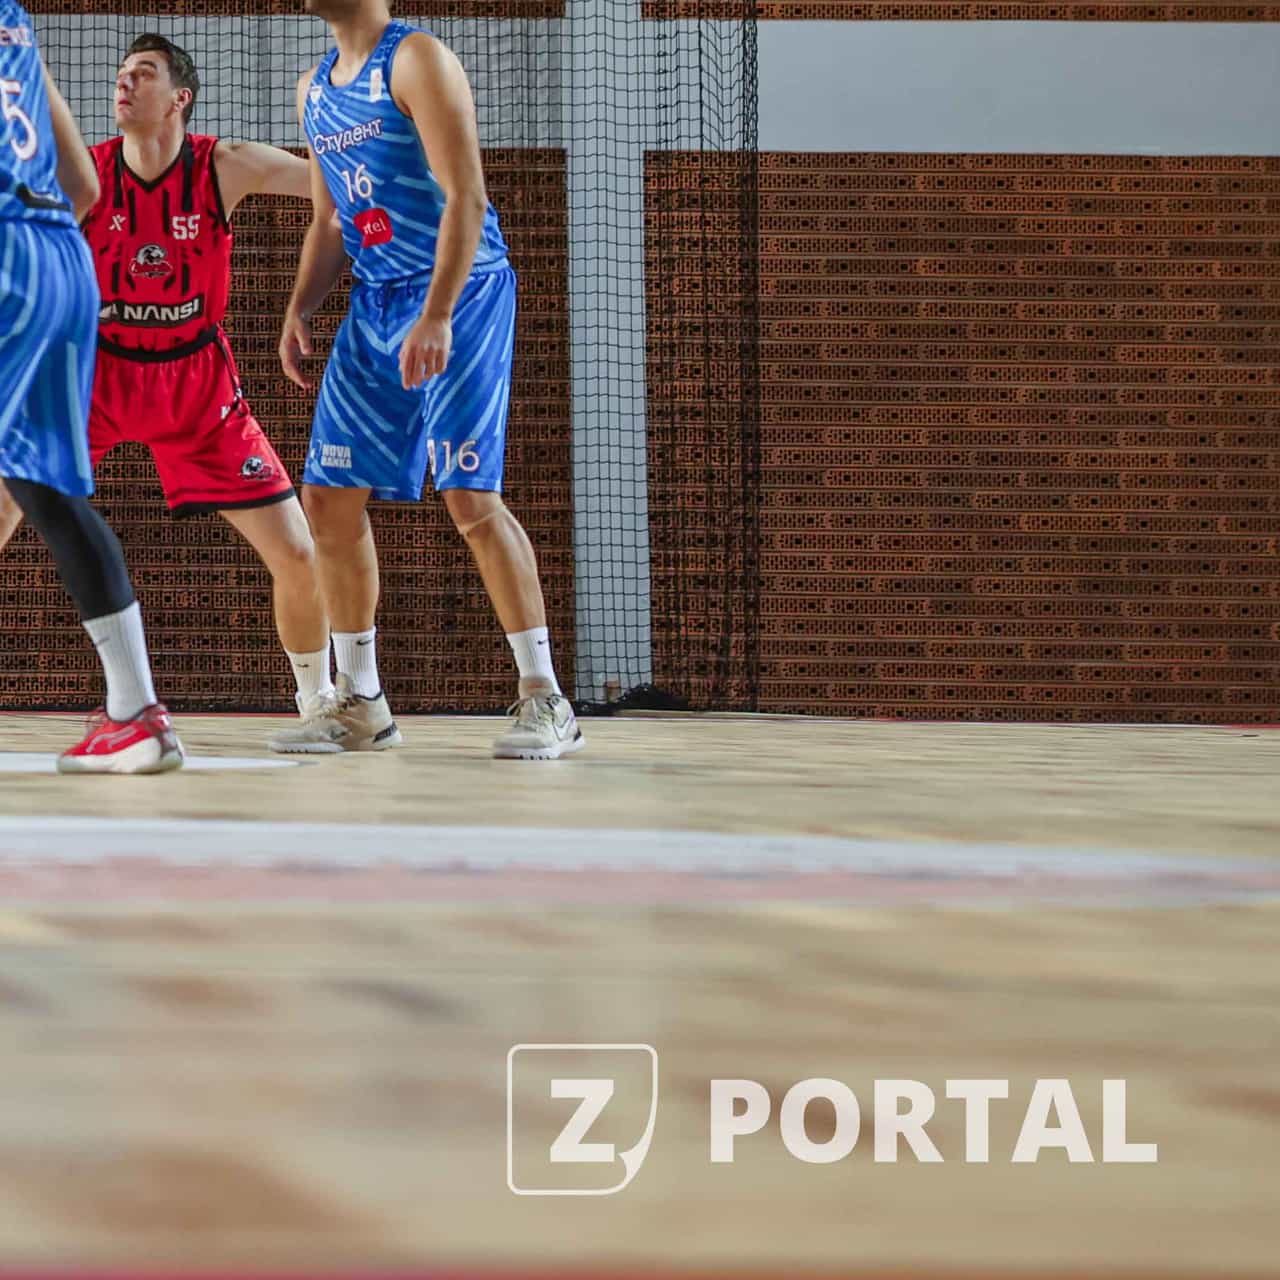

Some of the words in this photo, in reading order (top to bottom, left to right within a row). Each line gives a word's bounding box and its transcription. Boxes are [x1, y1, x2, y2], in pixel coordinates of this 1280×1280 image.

[314, 118, 384, 154] Студент
[341, 163, 372, 204] 16
[172, 214, 201, 240] 55
[124, 298, 200, 320] NANSI
[442, 440, 480, 472] 16
